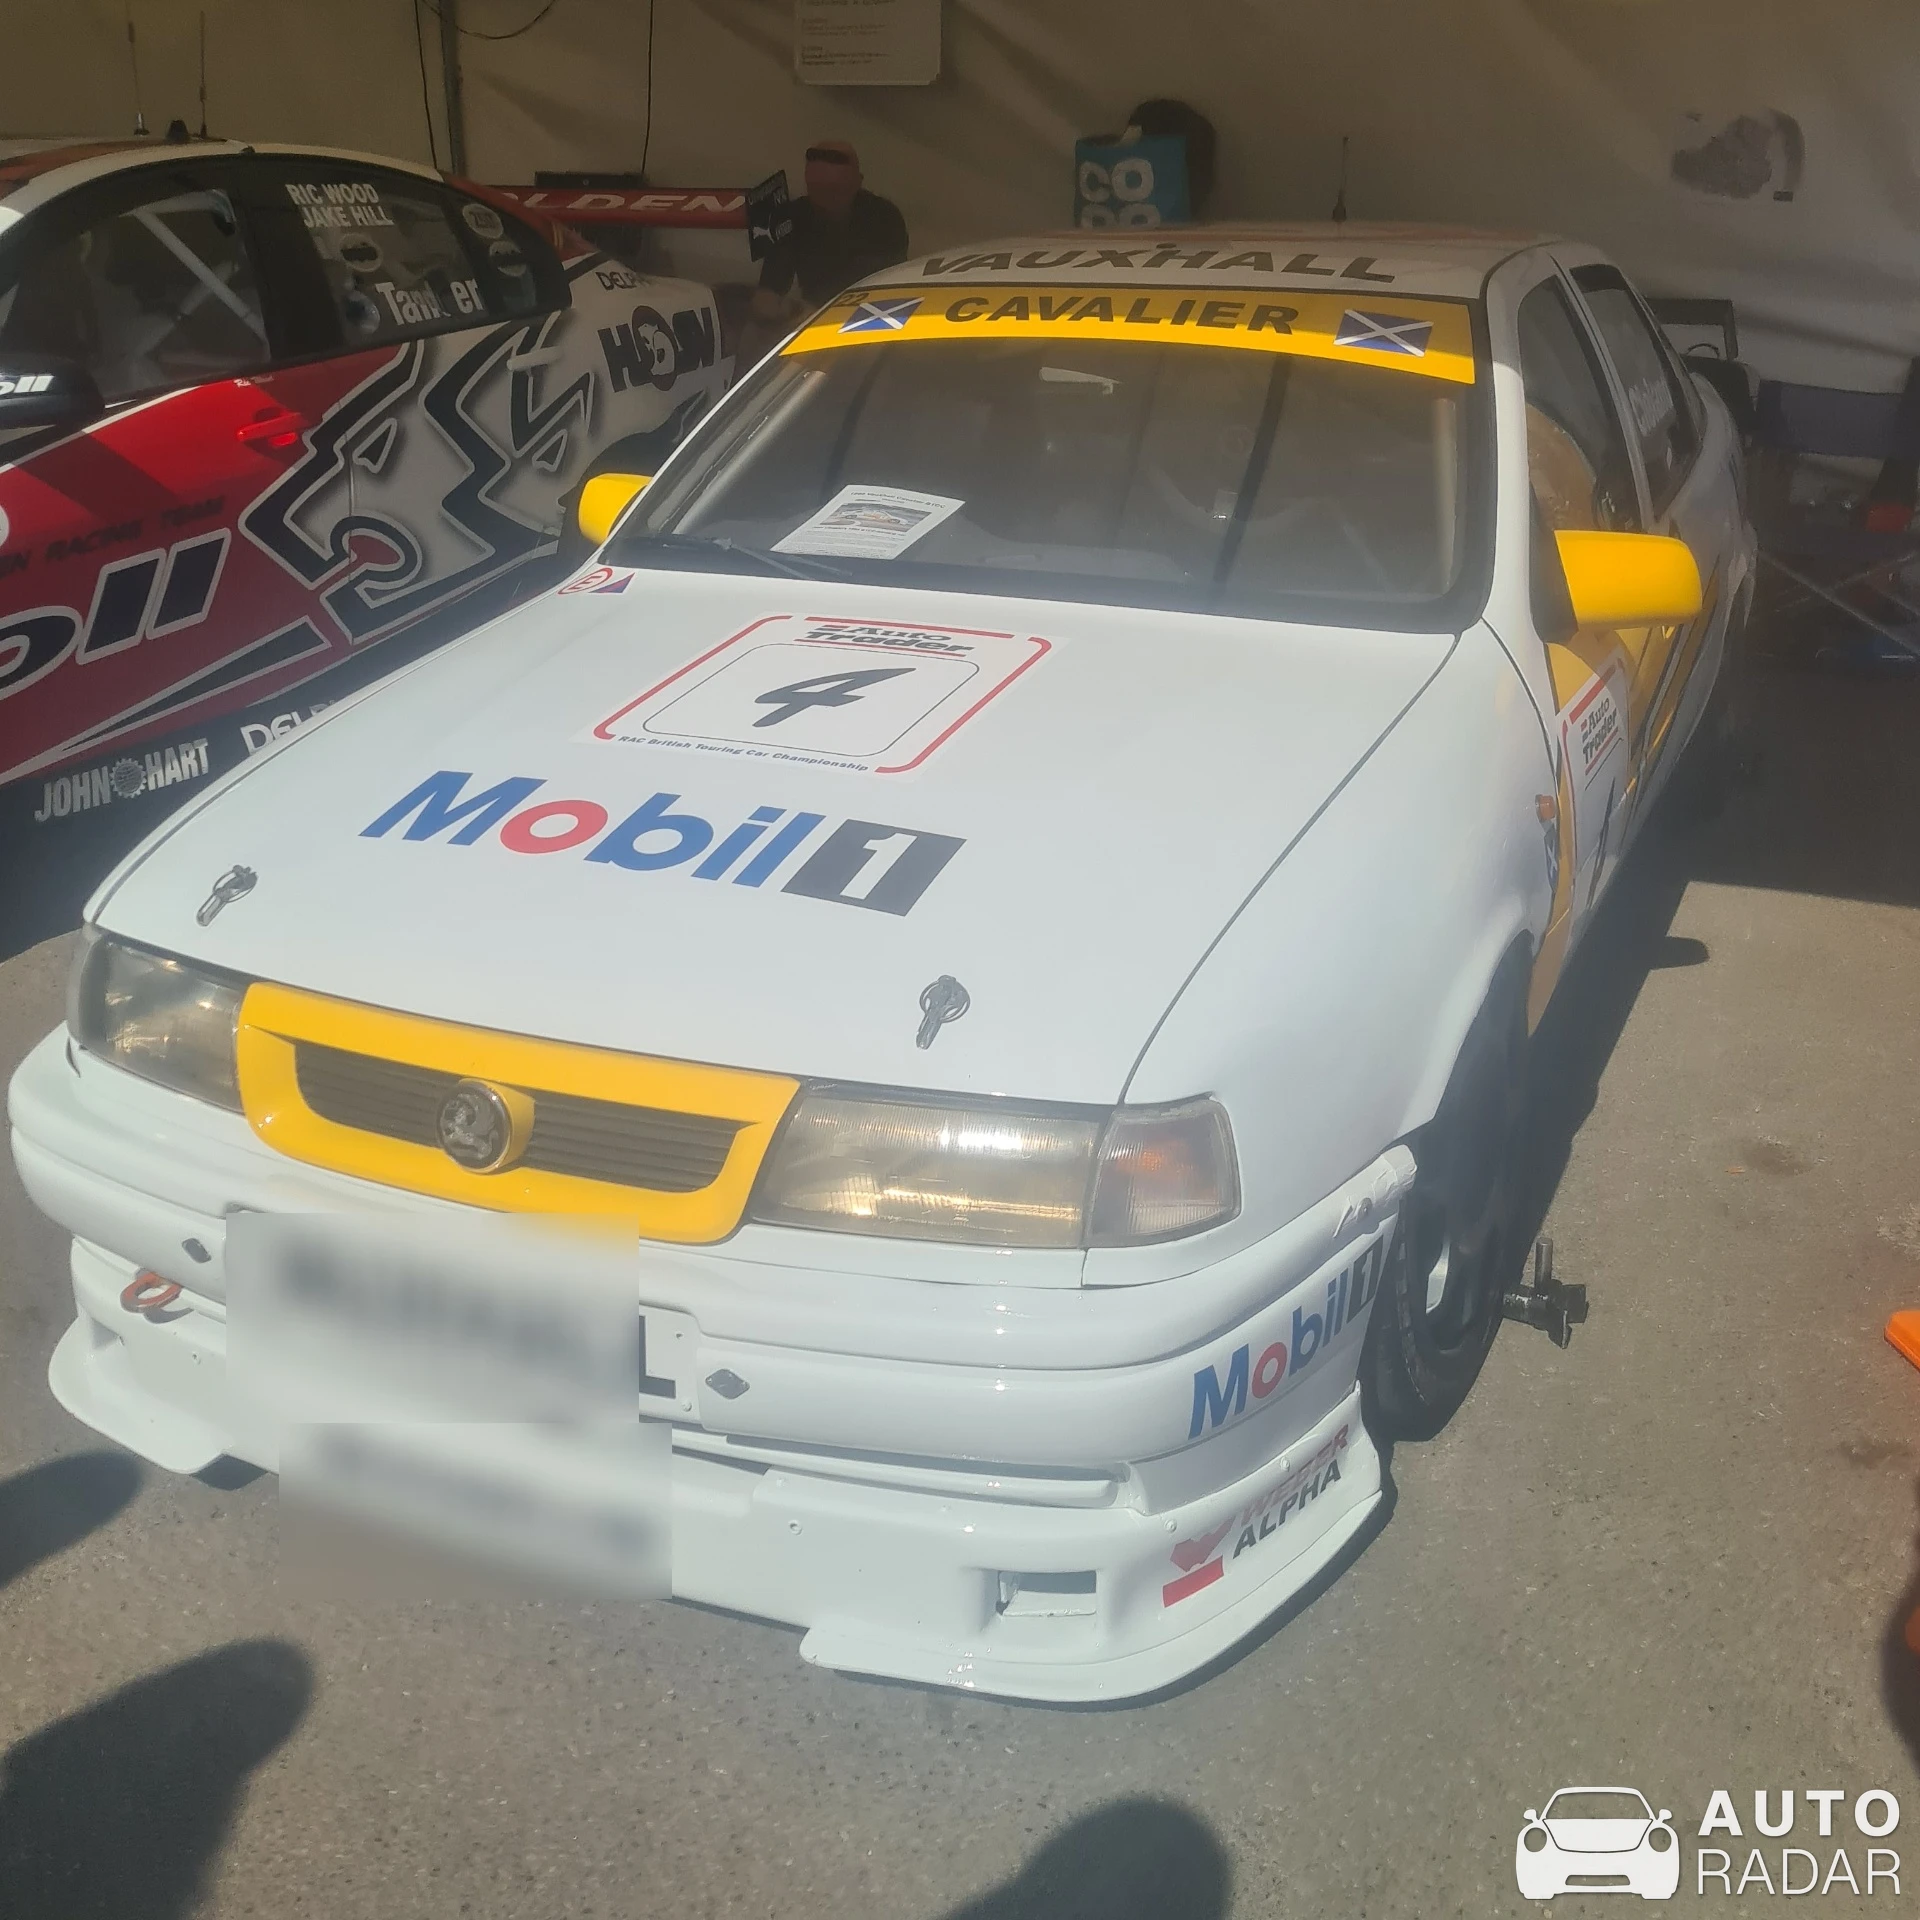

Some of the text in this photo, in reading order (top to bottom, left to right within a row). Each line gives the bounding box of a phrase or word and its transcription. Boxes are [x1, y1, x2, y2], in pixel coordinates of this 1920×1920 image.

[285, 183, 380, 205] RIC WOOD
[503, 192, 746, 213] LDEN
[302, 207, 395, 228] JAKE HILL
[921, 244, 1396, 283] VAUXHALL
[944, 296, 1300, 335] CAVALIER
[805, 630, 975, 652] Trader
[846, 625, 952, 642] Auto
[752, 667, 916, 728] 4
[618, 735, 869, 772] RAC British Touring Car Championship
[1582, 708, 1617, 765] Trader
[34, 765, 113, 823] JOHN
[144, 737, 209, 791] HART
[359, 770, 826, 888] Mobil
[1188, 1268, 1348, 1440] Mobil
[1233, 1459, 1342, 1559] ALPHA
